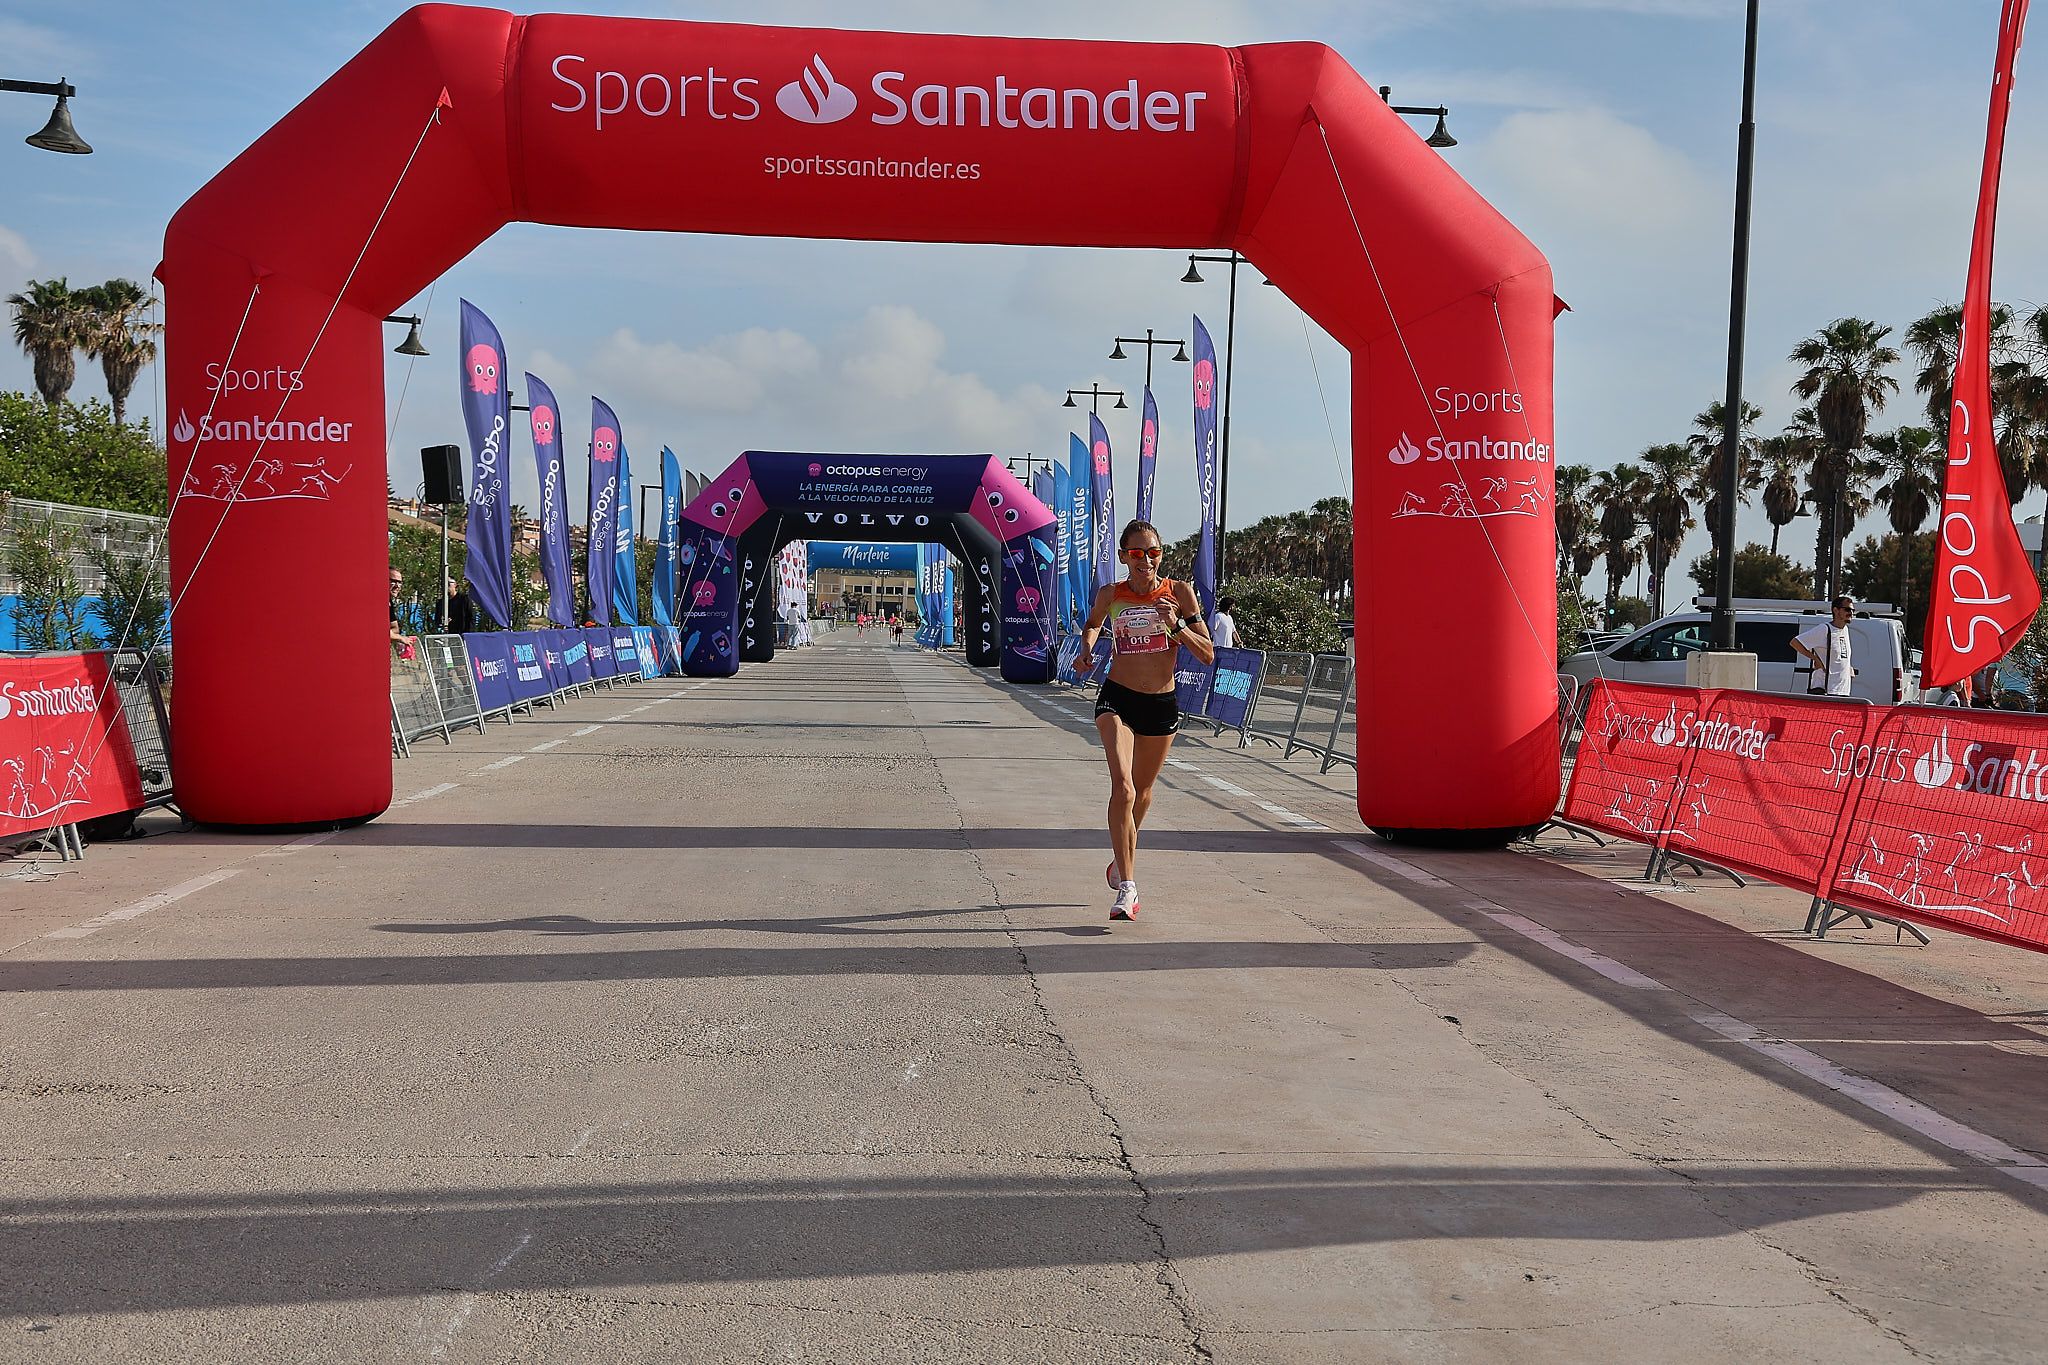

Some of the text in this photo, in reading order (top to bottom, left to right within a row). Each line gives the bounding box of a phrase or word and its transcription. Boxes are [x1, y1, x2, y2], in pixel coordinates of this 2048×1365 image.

[550, 54, 1207, 132] Sports Santander
[764, 154, 981, 180] sportssantander.es
[206, 362, 304, 397] Sports
[1435, 386, 1522, 419] Sports
[200, 414, 353, 443] Santander
[1426, 435, 1550, 463] Santander
[826, 465, 928, 480] octopus energy
[799, 482, 932, 494] LA ENERGÍA PARA CORRER
[824, 494, 881, 503] VELOCIDAD
[804, 512, 930, 526] VOLVO
[842, 545, 890, 566] Marlene
[744, 559, 755, 649] VOLVO
[980, 564, 991, 653] VOLVO
[1130, 635, 1151, 645] 016
[2, 678, 98, 717] Santander
[1599, 702, 1776, 761] Sports Santander
[1821, 729, 1911, 788] Sports
